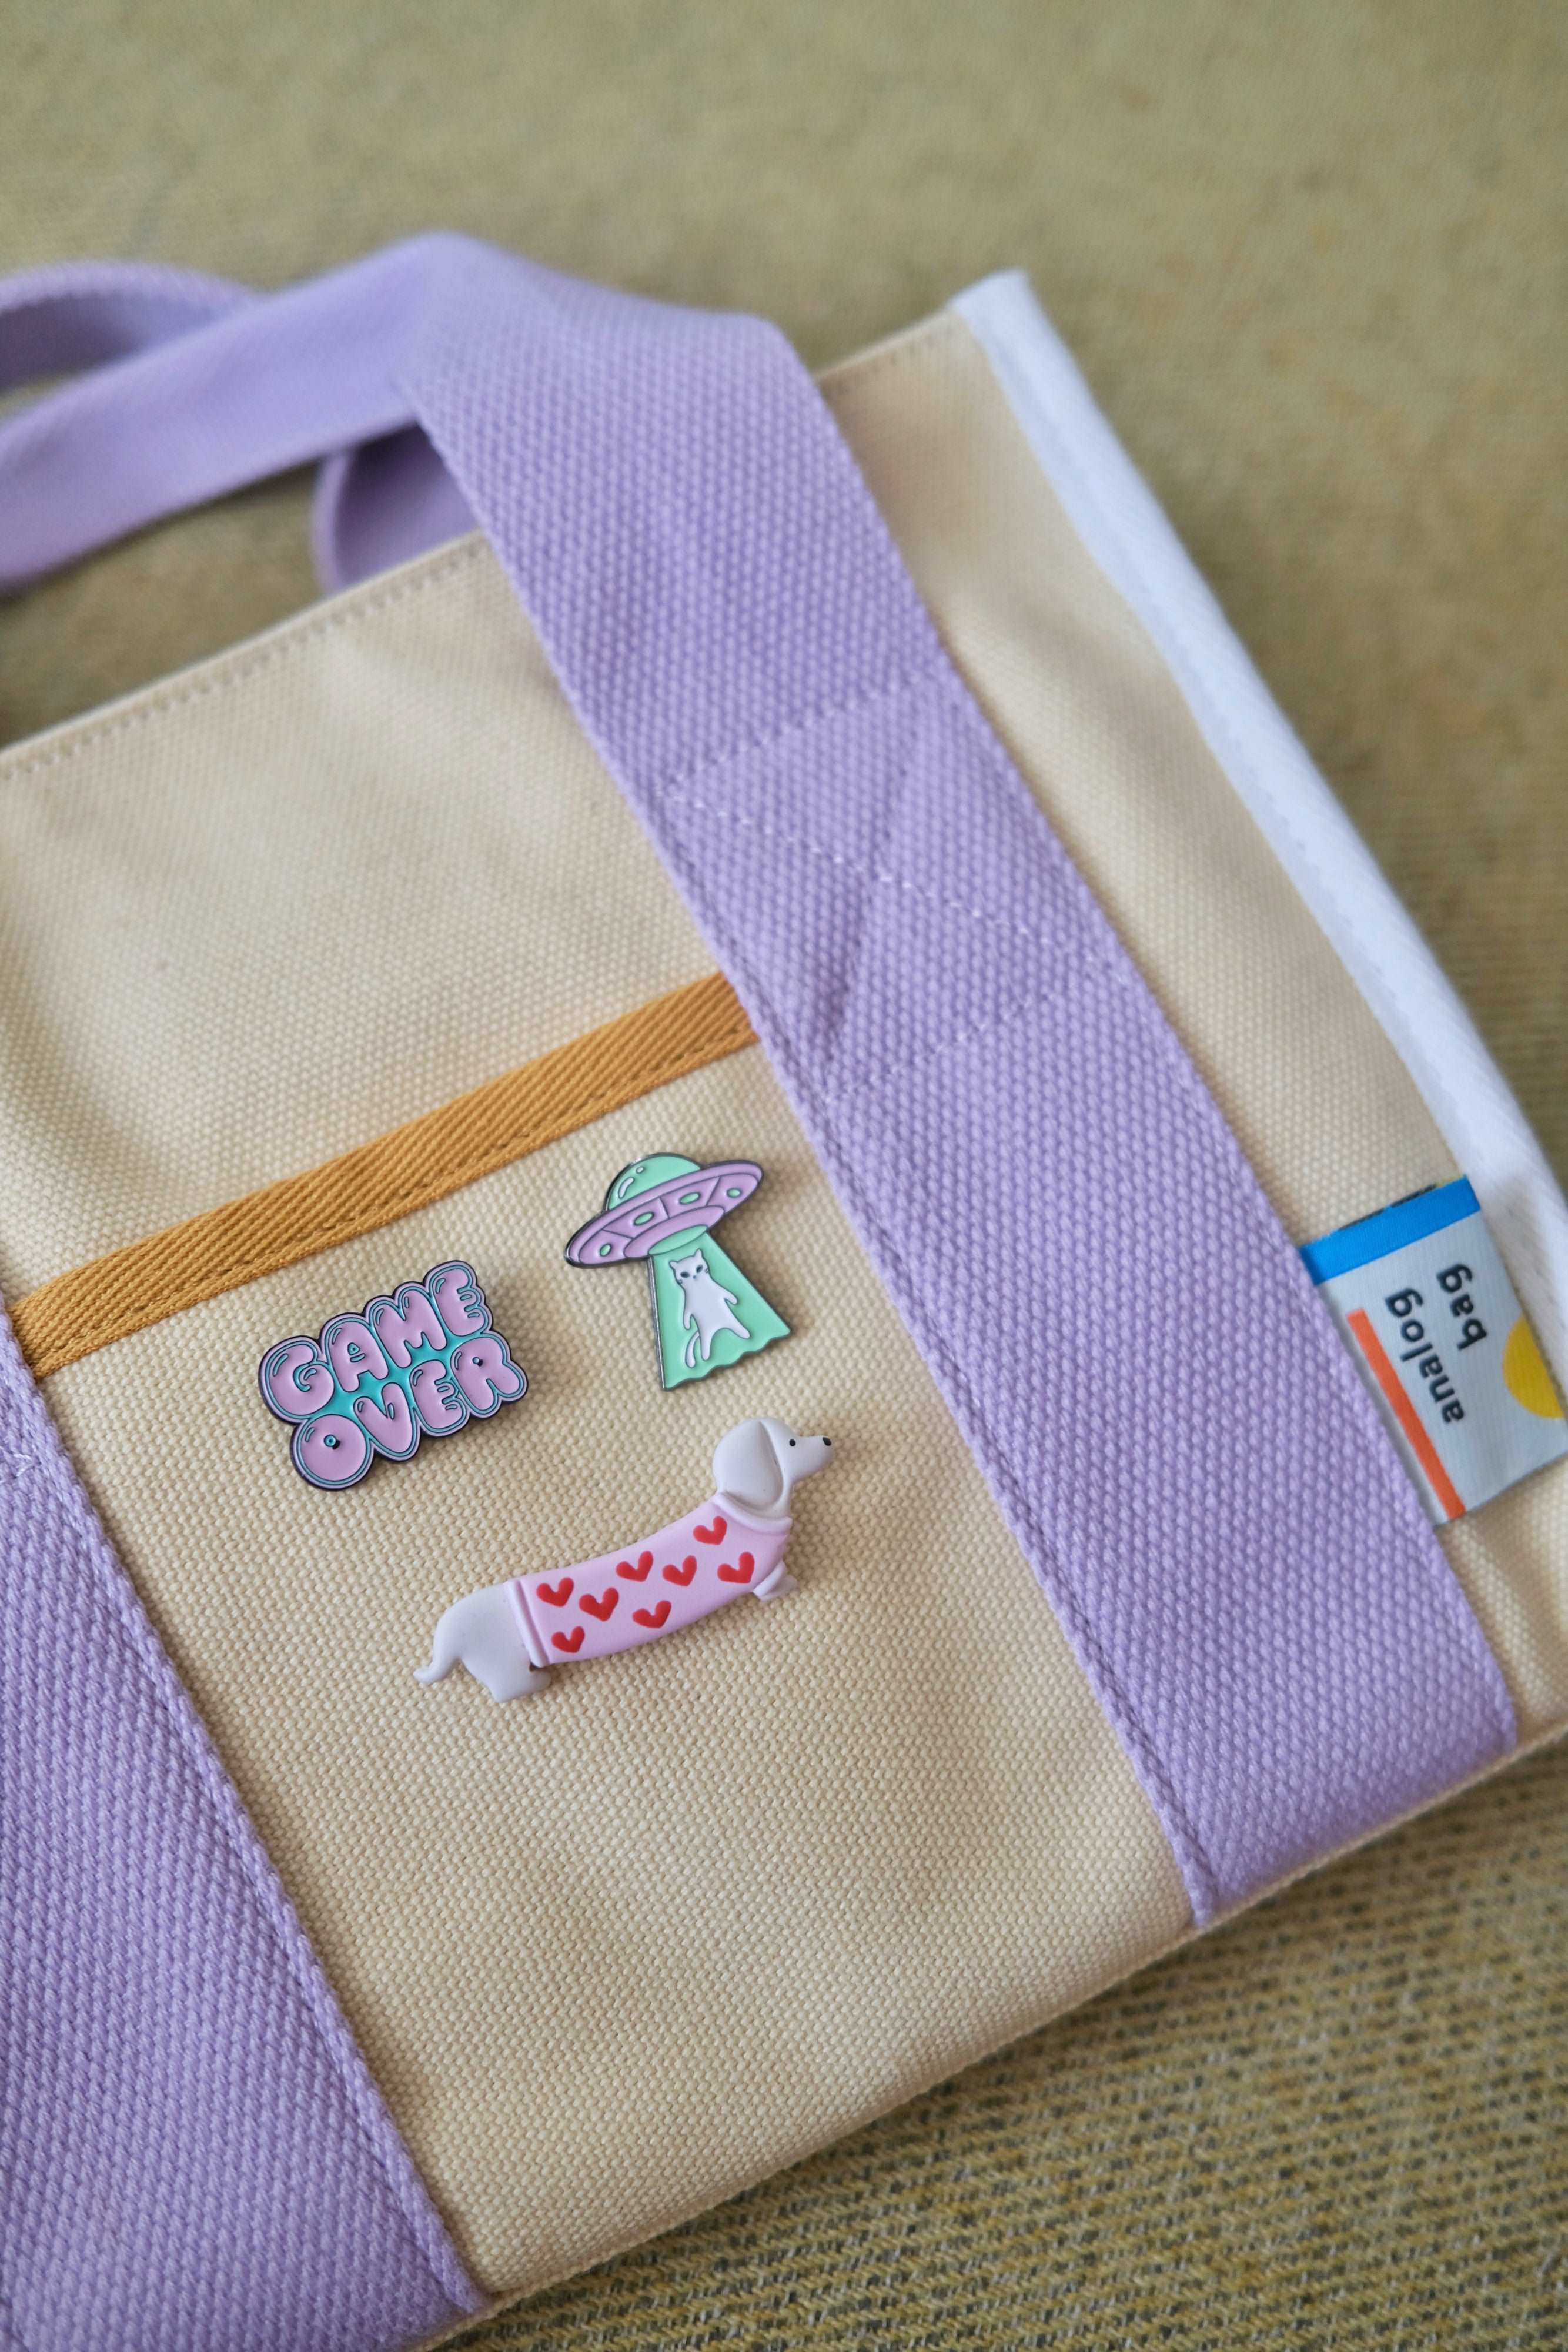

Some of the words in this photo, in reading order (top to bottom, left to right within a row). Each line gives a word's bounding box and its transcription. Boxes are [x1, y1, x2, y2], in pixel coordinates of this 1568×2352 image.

[265, 1264, 489, 1419] GAME
[1385, 1288, 1465, 1424] analog
[1436, 1264, 1487, 1351] bag
[296, 1333, 524, 1485] OVER
